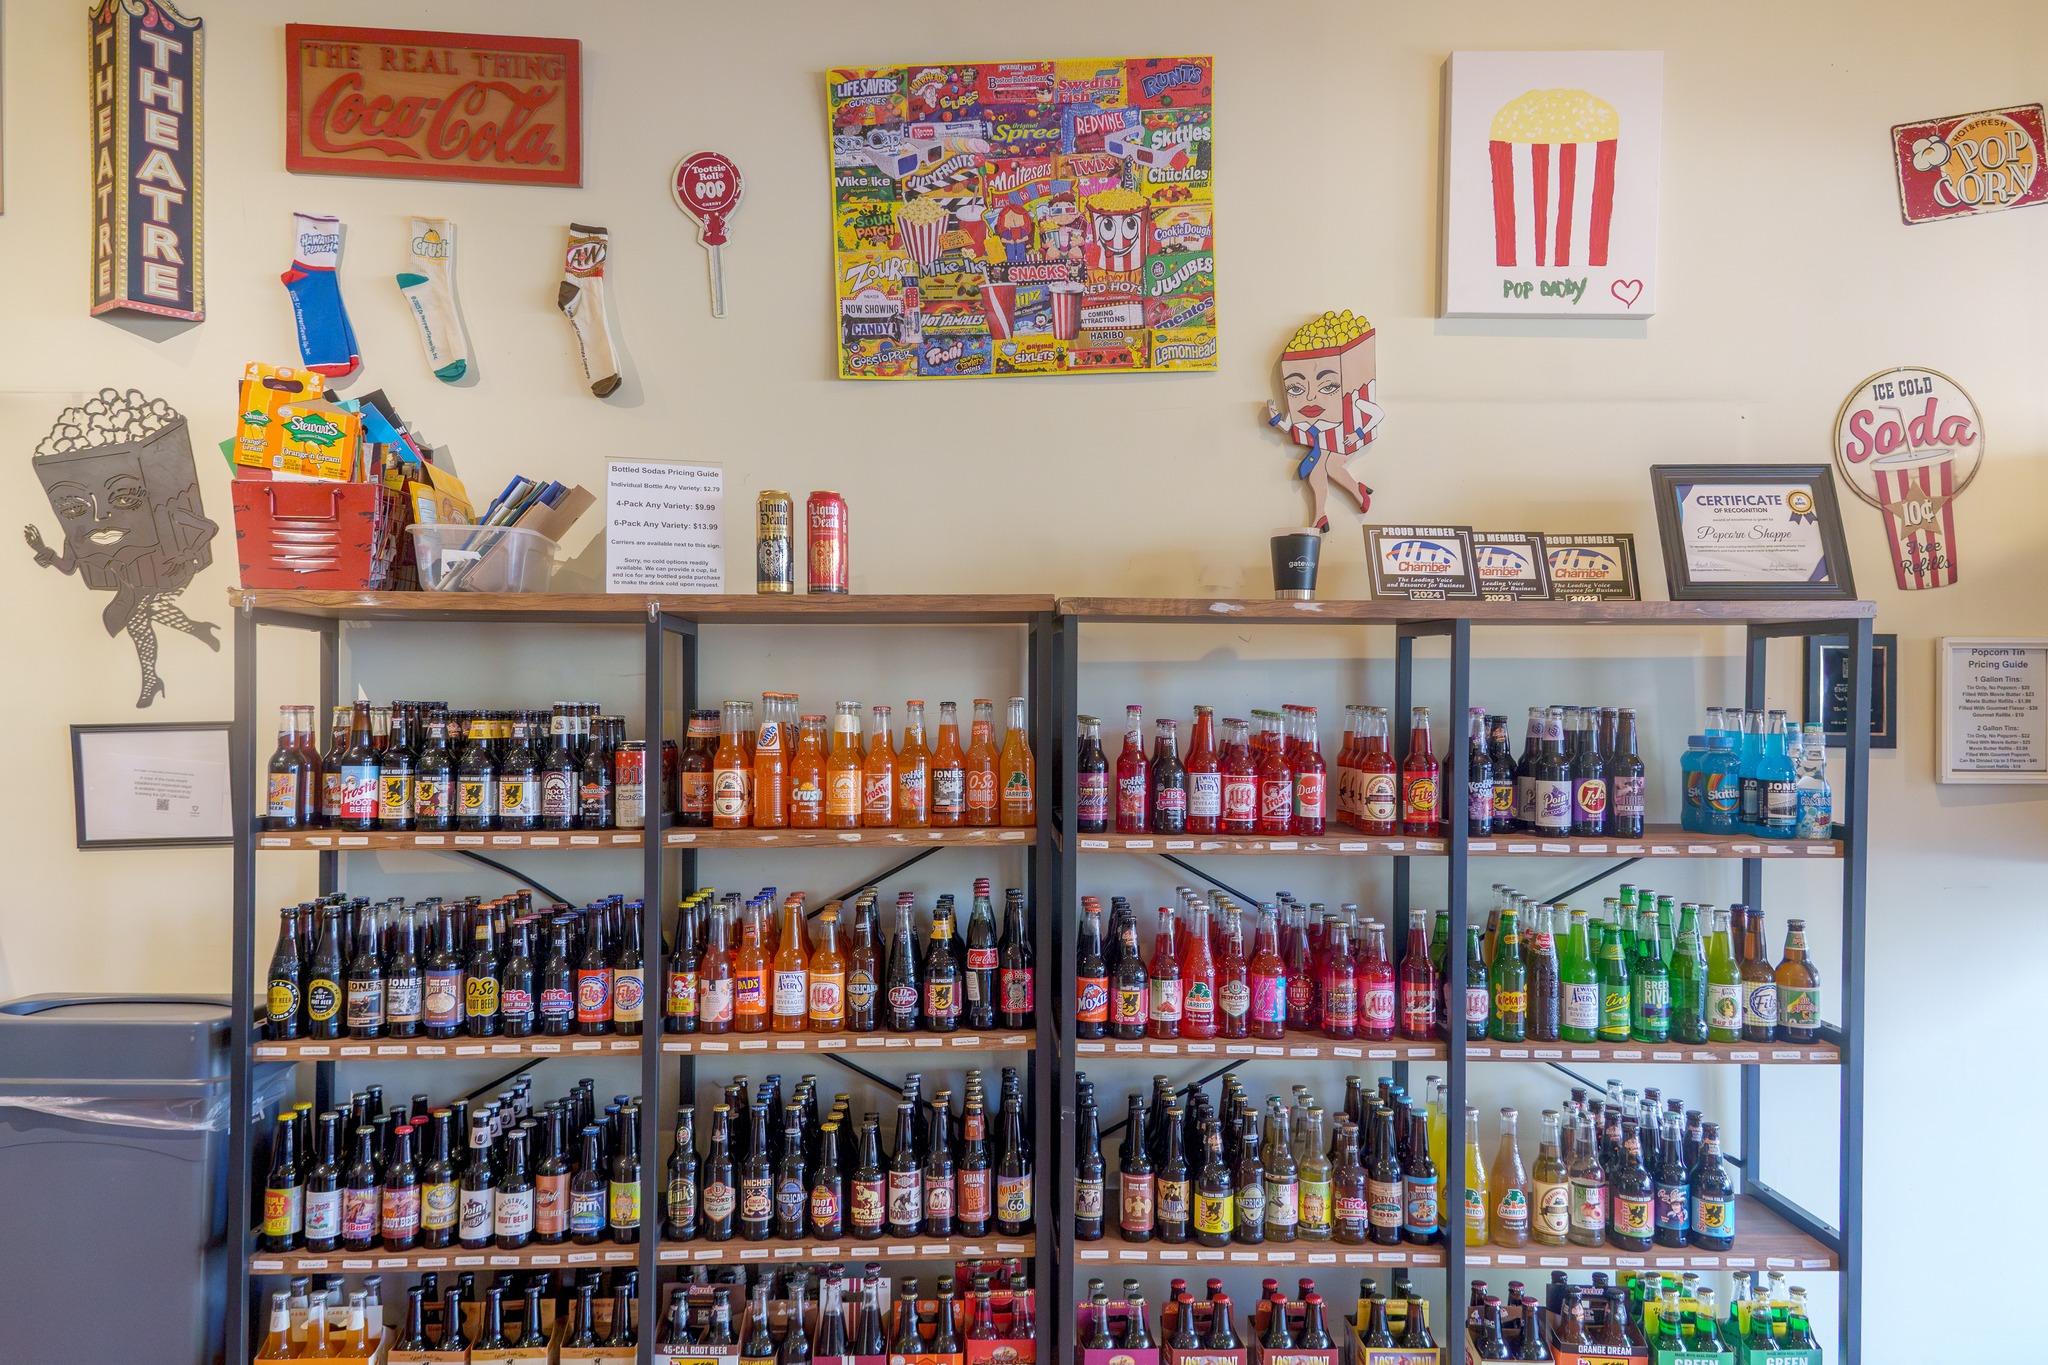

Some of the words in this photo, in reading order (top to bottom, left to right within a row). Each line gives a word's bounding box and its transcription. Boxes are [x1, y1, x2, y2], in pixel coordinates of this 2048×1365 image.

[303, 41, 362, 69] THE
[380, 46, 459, 75] REAL
[473, 51, 564, 81] THING
[910, 72, 948, 92] WARHEADS
[1058, 76, 1121, 91] Swedish
[1142, 64, 1202, 98] RUNTS
[837, 80, 861, 98] LIFE
[861, 79, 898, 95] SAVERS
[849, 97, 887, 108] GUMMIES
[940, 91, 979, 110] CUBES
[1058, 91, 1091, 103] Fish
[993, 124, 1059, 143] Spree
[1151, 124, 1211, 150] Skittles
[1952, 129, 2030, 174] POP
[95, 28, 113, 296] THEATRE
[136, 30, 188, 302] THEATRE
[692, 164, 726, 174] Tootsie
[1069, 155, 1114, 177] Twix
[835, 176, 867, 188] Mike
[871, 176, 891, 187] Ike
[989, 161, 1052, 191] Maltesers
[1148, 166, 1208, 184] Chuckles
[696, 181, 726, 199] POP
[1933, 164, 2031, 208] CORN
[856, 215, 891, 226] SOUR
[856, 224, 894, 239] PATCH
[1154, 227, 1184, 241] Cookie
[1185, 224, 1211, 237] Dough
[304, 244, 335, 255] PUNCH
[412, 240, 450, 261] Crush
[845, 257, 907, 293] ZOURS
[918, 260, 958, 278] Mike
[964, 259, 987, 274] Ike
[1008, 265, 1066, 281] SNACKS
[1151, 257, 1213, 296] JUJUBES
[1082, 283, 1106, 296] RED
[1110, 282, 1143, 295] HOTS
[1503, 279, 1533, 299] POP
[1540, 276, 1588, 305] DADDY
[845, 305, 863, 314] NOW
[865, 304, 898, 314] SHOWING
[1087, 310, 1114, 318] COMING
[1155, 297, 1214, 329] mentos
[921, 314, 940, 328] HOT
[940, 313, 984, 326] TAMALES
[853, 323, 890, 335] CANDY
[1090, 331, 1124, 340] HARIBO
[926, 342, 963, 365] Trolli
[1015, 351, 1054, 364] SIXLETS
[1155, 338, 1216, 366] Lemonhead
[851, 351, 913, 368] GOBSTOPPER
[1872, 382, 1895, 402] ICE
[1899, 377, 1933, 397] COLD
[1846, 397, 1977, 464] Soda
[316, 452, 341, 464] Cream
[611, 465, 639, 474] Bottled
[641, 467, 666, 475] Sodas
[668, 469, 695, 478] Pricing
[697, 470, 719, 478] Guide
[616, 500, 643, 508] 4-Pack
[645, 501, 661, 510] Any
[663, 502, 693, 511] Variety:
[695, 503, 716, 511] $9.99
[759, 501, 788, 515] Liquid
[1696, 495, 1783, 507] CERTIFICATE
[809, 502, 839, 518] Liquid
[1902, 500, 1934, 527] 10¢
[614, 519, 641, 528] 6-Pack
[643, 521, 660, 529] Any
[661, 521, 691, 530] Variety:
[693, 523, 718, 531] $13.99
[760, 513, 788, 526] Death
[811, 515, 839, 529] Death
[1382, 527, 1414, 536] PROUD
[1416, 527, 1455, 537] MEMBER
[1486, 534, 1526, 542] MEMBER
[1697, 525, 1745, 543] Popcorn
[1748, 524, 1792, 543] Shoppe
[1906, 540, 1942, 555] Free
[1289, 560, 1317, 570] gateway
[1398, 561, 1451, 572] Chamber
[1900, 555, 1953, 577] Refills
[1555, 568, 1609, 578] Chamber
[1413, 591, 1441, 599] 2024
[1972, 649, 2009, 657] Popcorn
[1968, 661, 1999, 670] Pricing
[758, 725, 777, 747] Fanta
[934, 770, 963, 778] JONES
[969, 774, 994, 788] O-So
[342, 780, 377, 804] Frostie
[792, 789, 823, 800] Crush
[1297, 778, 1325, 797] Dang!
[970, 789, 994, 801] ORANGE
[1167, 791, 1182, 799] IBC
[349, 982, 382, 990] JONES
[389, 978, 422, 986] JONES
[468, 980, 494, 995] O-So
[737, 978, 759, 990] DAD'S
[547, 992, 564, 1000] IBC
[891, 992, 917, 1005] Pepper
[900, 988, 911, 997] Dr
[1077, 993, 1108, 1013] MOXIE
[743, 1179, 772, 1187] ANCHOR
[963, 1174, 985, 1184] SARANAC
[965, 1188, 983, 1199] ROOT
[571, 1200, 601, 1215] ABITA
[813, 1199, 830, 1207] ROOT
[968, 1198, 986, 1210] BEER
[1009, 1202, 1023, 1211] 66
[813, 1207, 832, 1215] BEER
[498, 1215, 512, 1224] ROOT
[512, 1213, 529, 1223] BEER
[663, 1345, 689, 1355] 45-CAL
[690, 1345, 708, 1355] ROOT
[709, 1345, 728, 1355] BEER
[1578, 1345, 1605, 1355] ORANGE
[1607, 1346, 1632, 1356] DREAM
